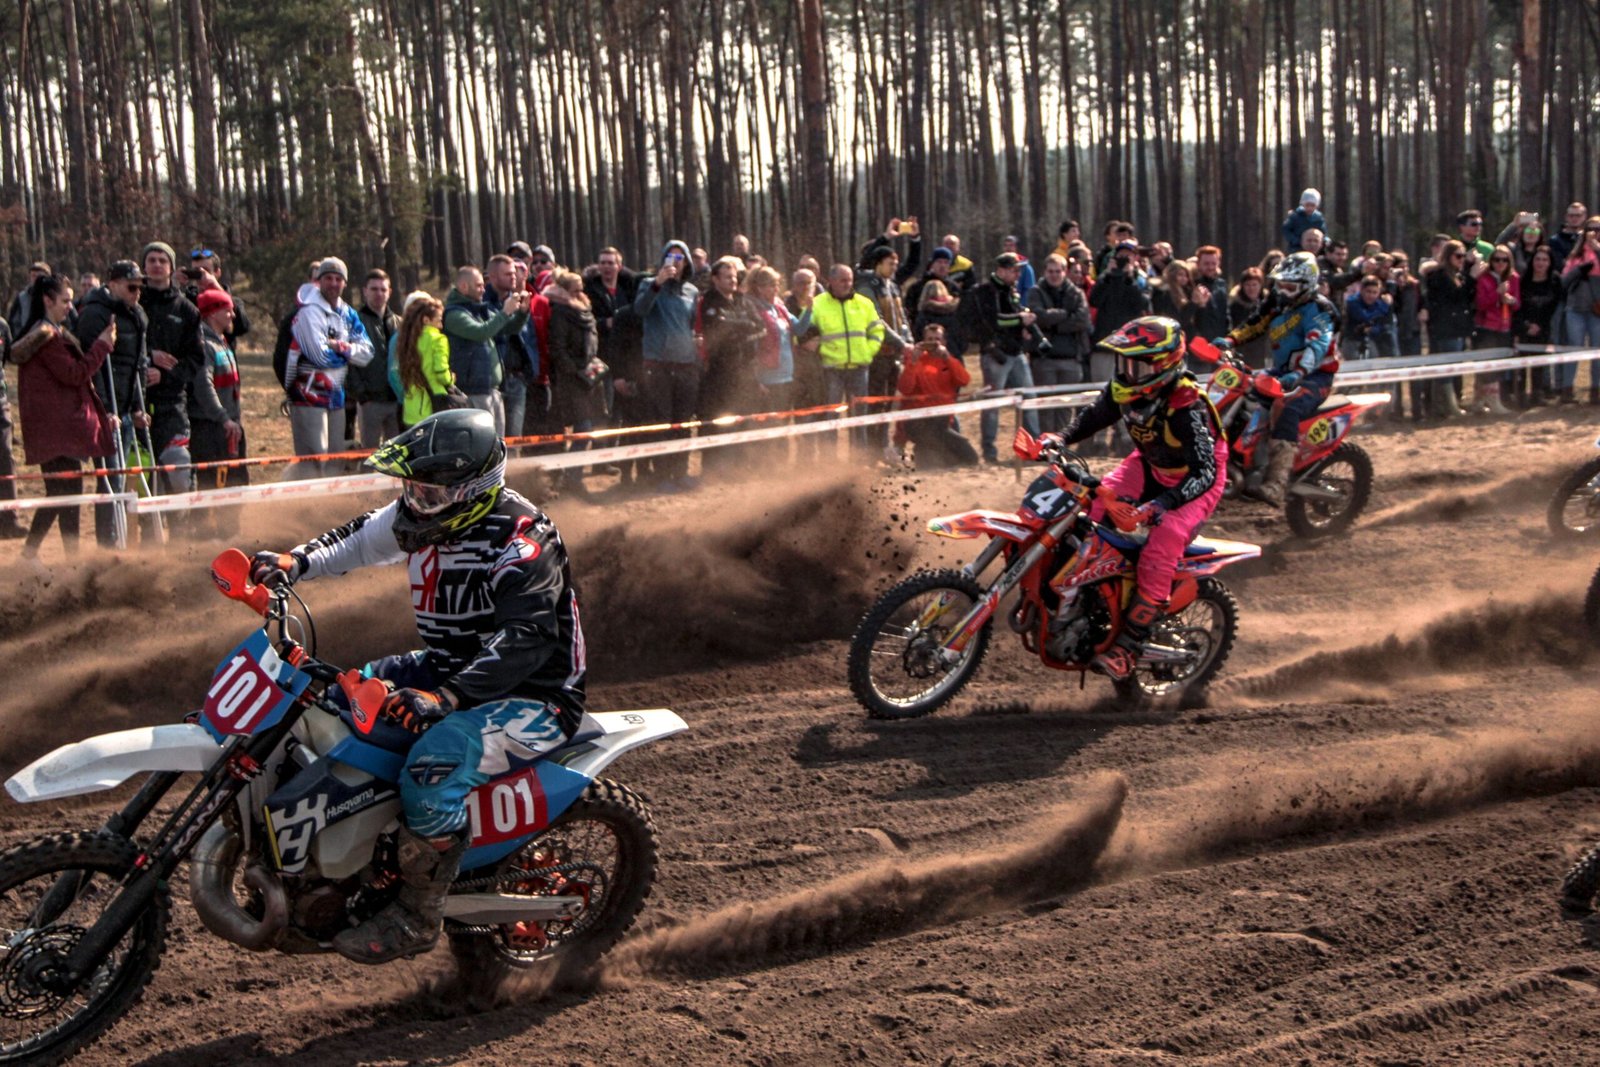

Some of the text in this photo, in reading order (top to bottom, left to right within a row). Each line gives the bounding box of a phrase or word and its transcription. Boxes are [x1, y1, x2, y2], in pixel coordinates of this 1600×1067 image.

[1309, 418, 1328, 443] 196
[1031, 487, 1064, 516] 4
[208, 655, 272, 730] 101
[326, 787, 375, 820] Husqvarna
[464, 778, 535, 838] 101
